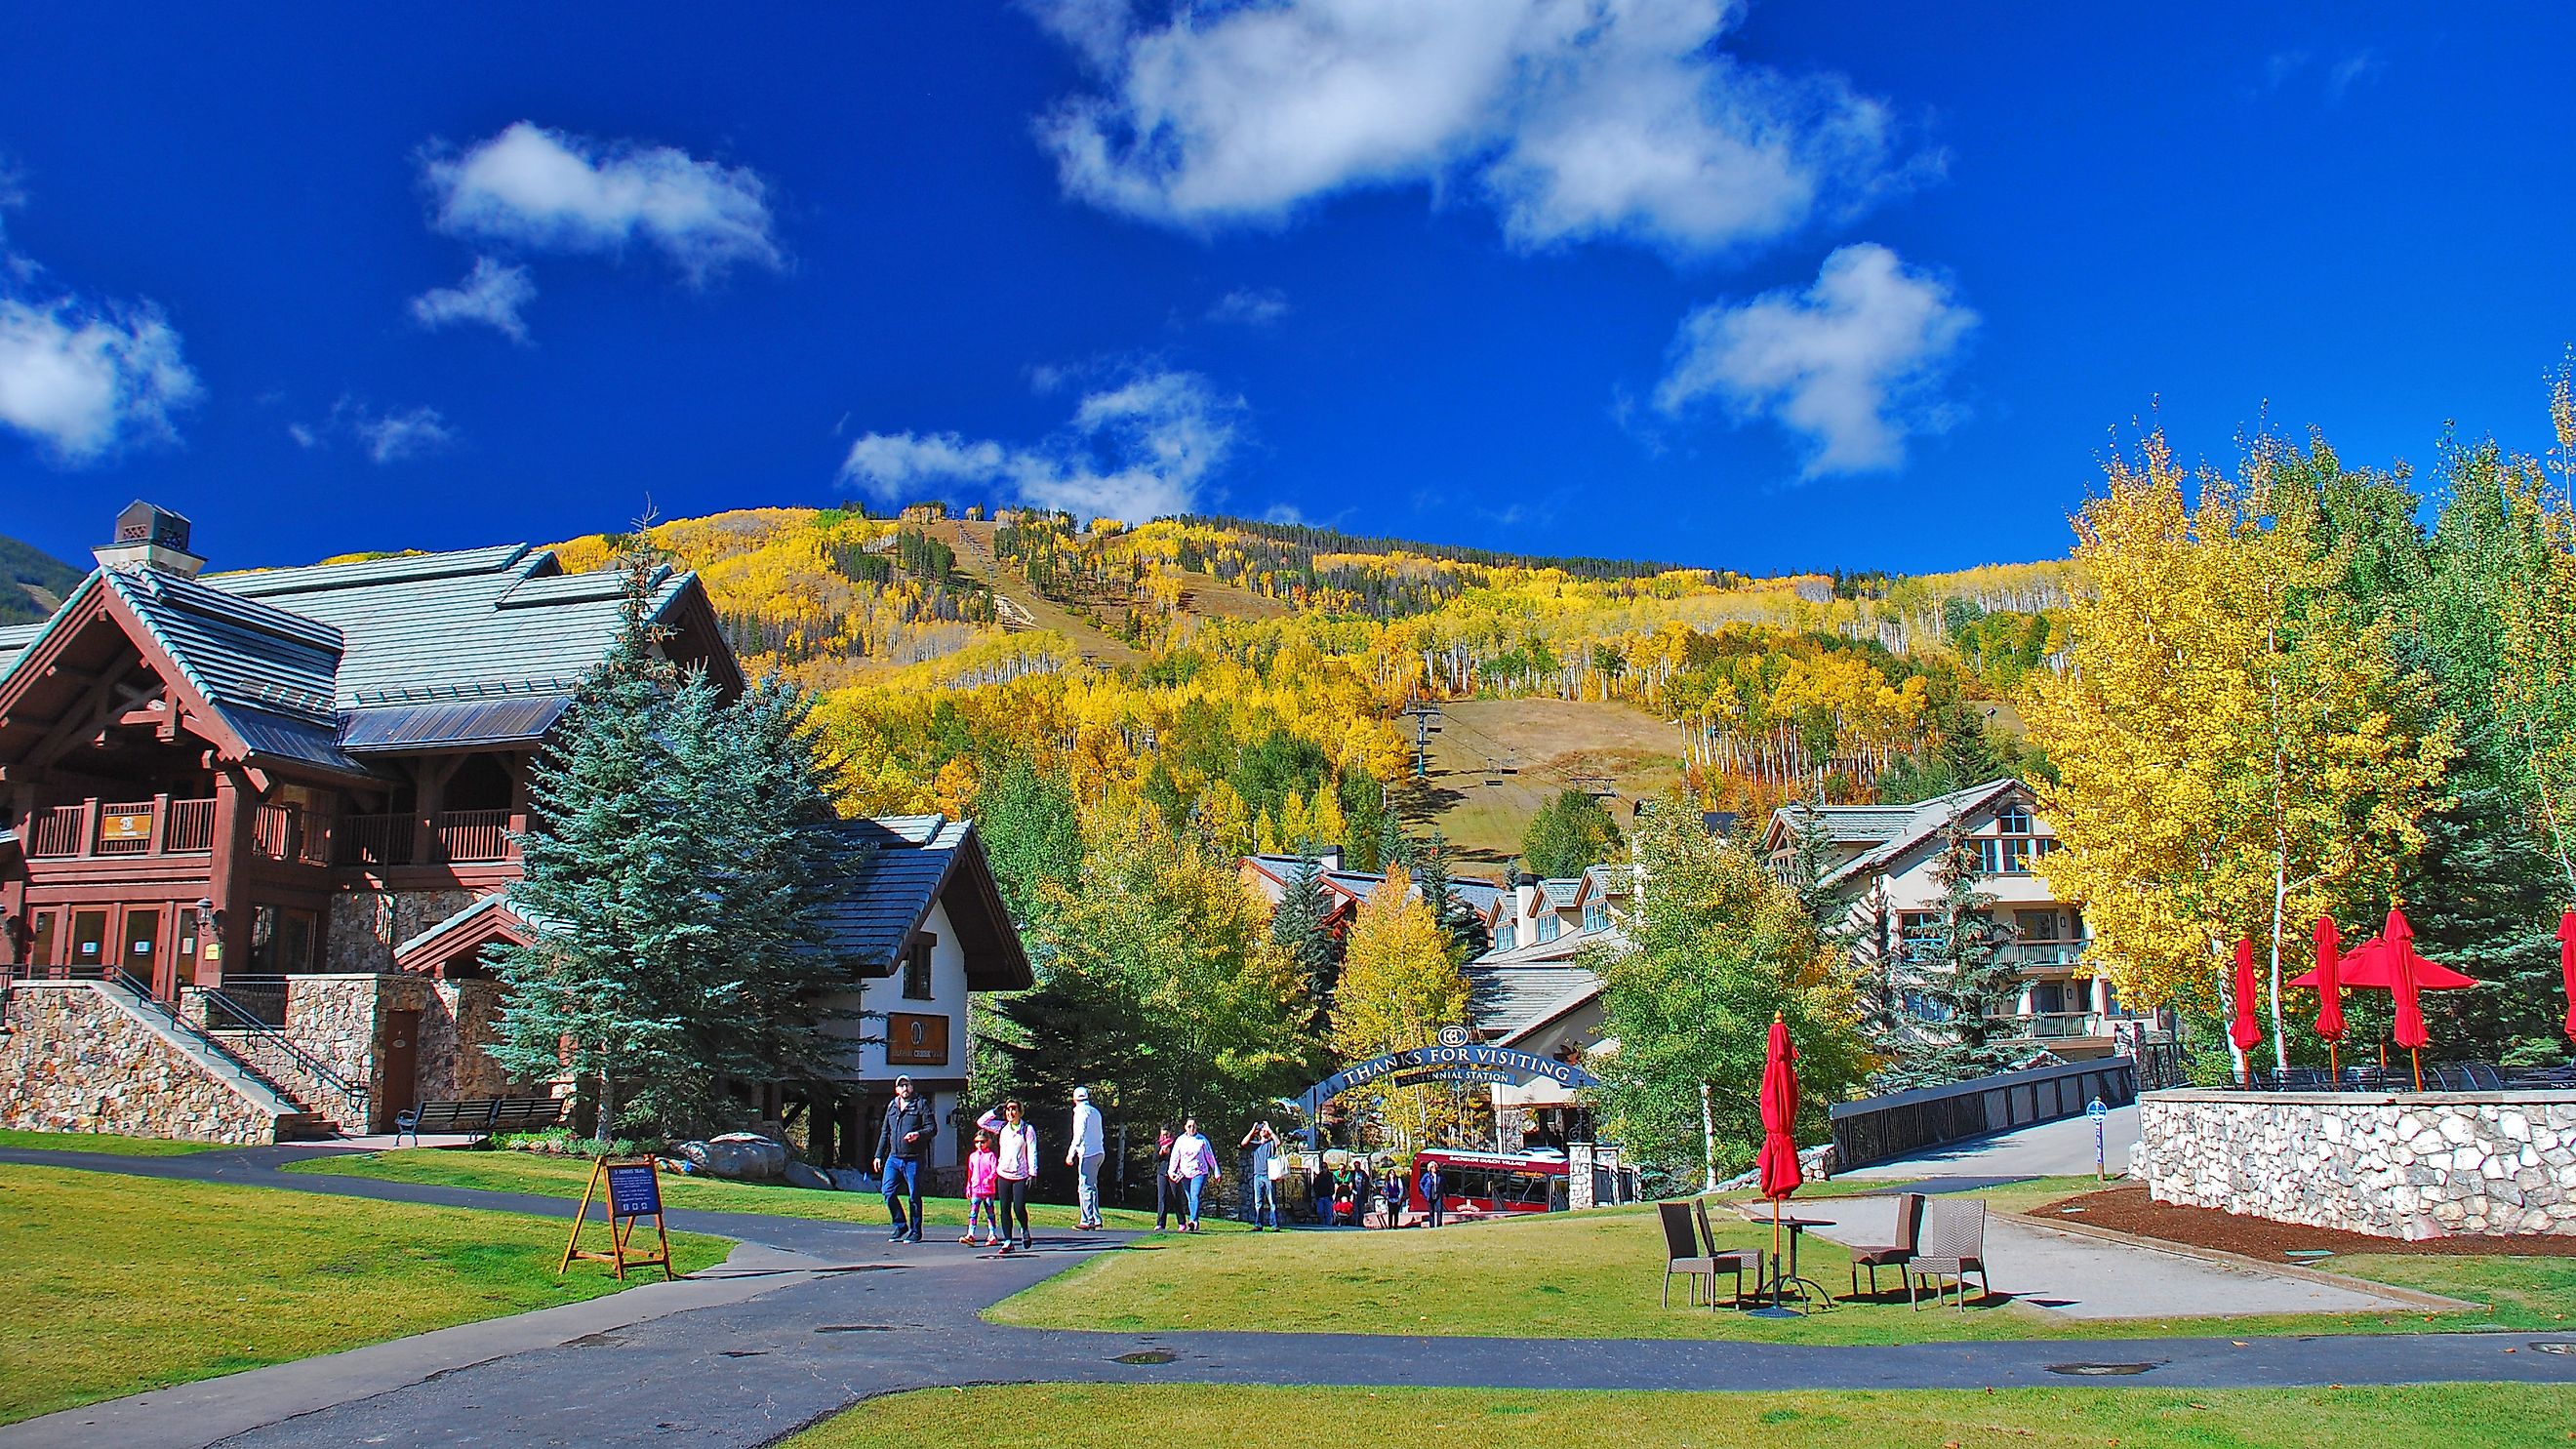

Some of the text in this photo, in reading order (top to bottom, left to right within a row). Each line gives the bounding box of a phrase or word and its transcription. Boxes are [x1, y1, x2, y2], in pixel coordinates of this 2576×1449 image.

[1342, 1048, 1570, 1085] THANKS FOR VISITING
[1400, 1070, 1509, 1085] CENTENNIAL STATION
